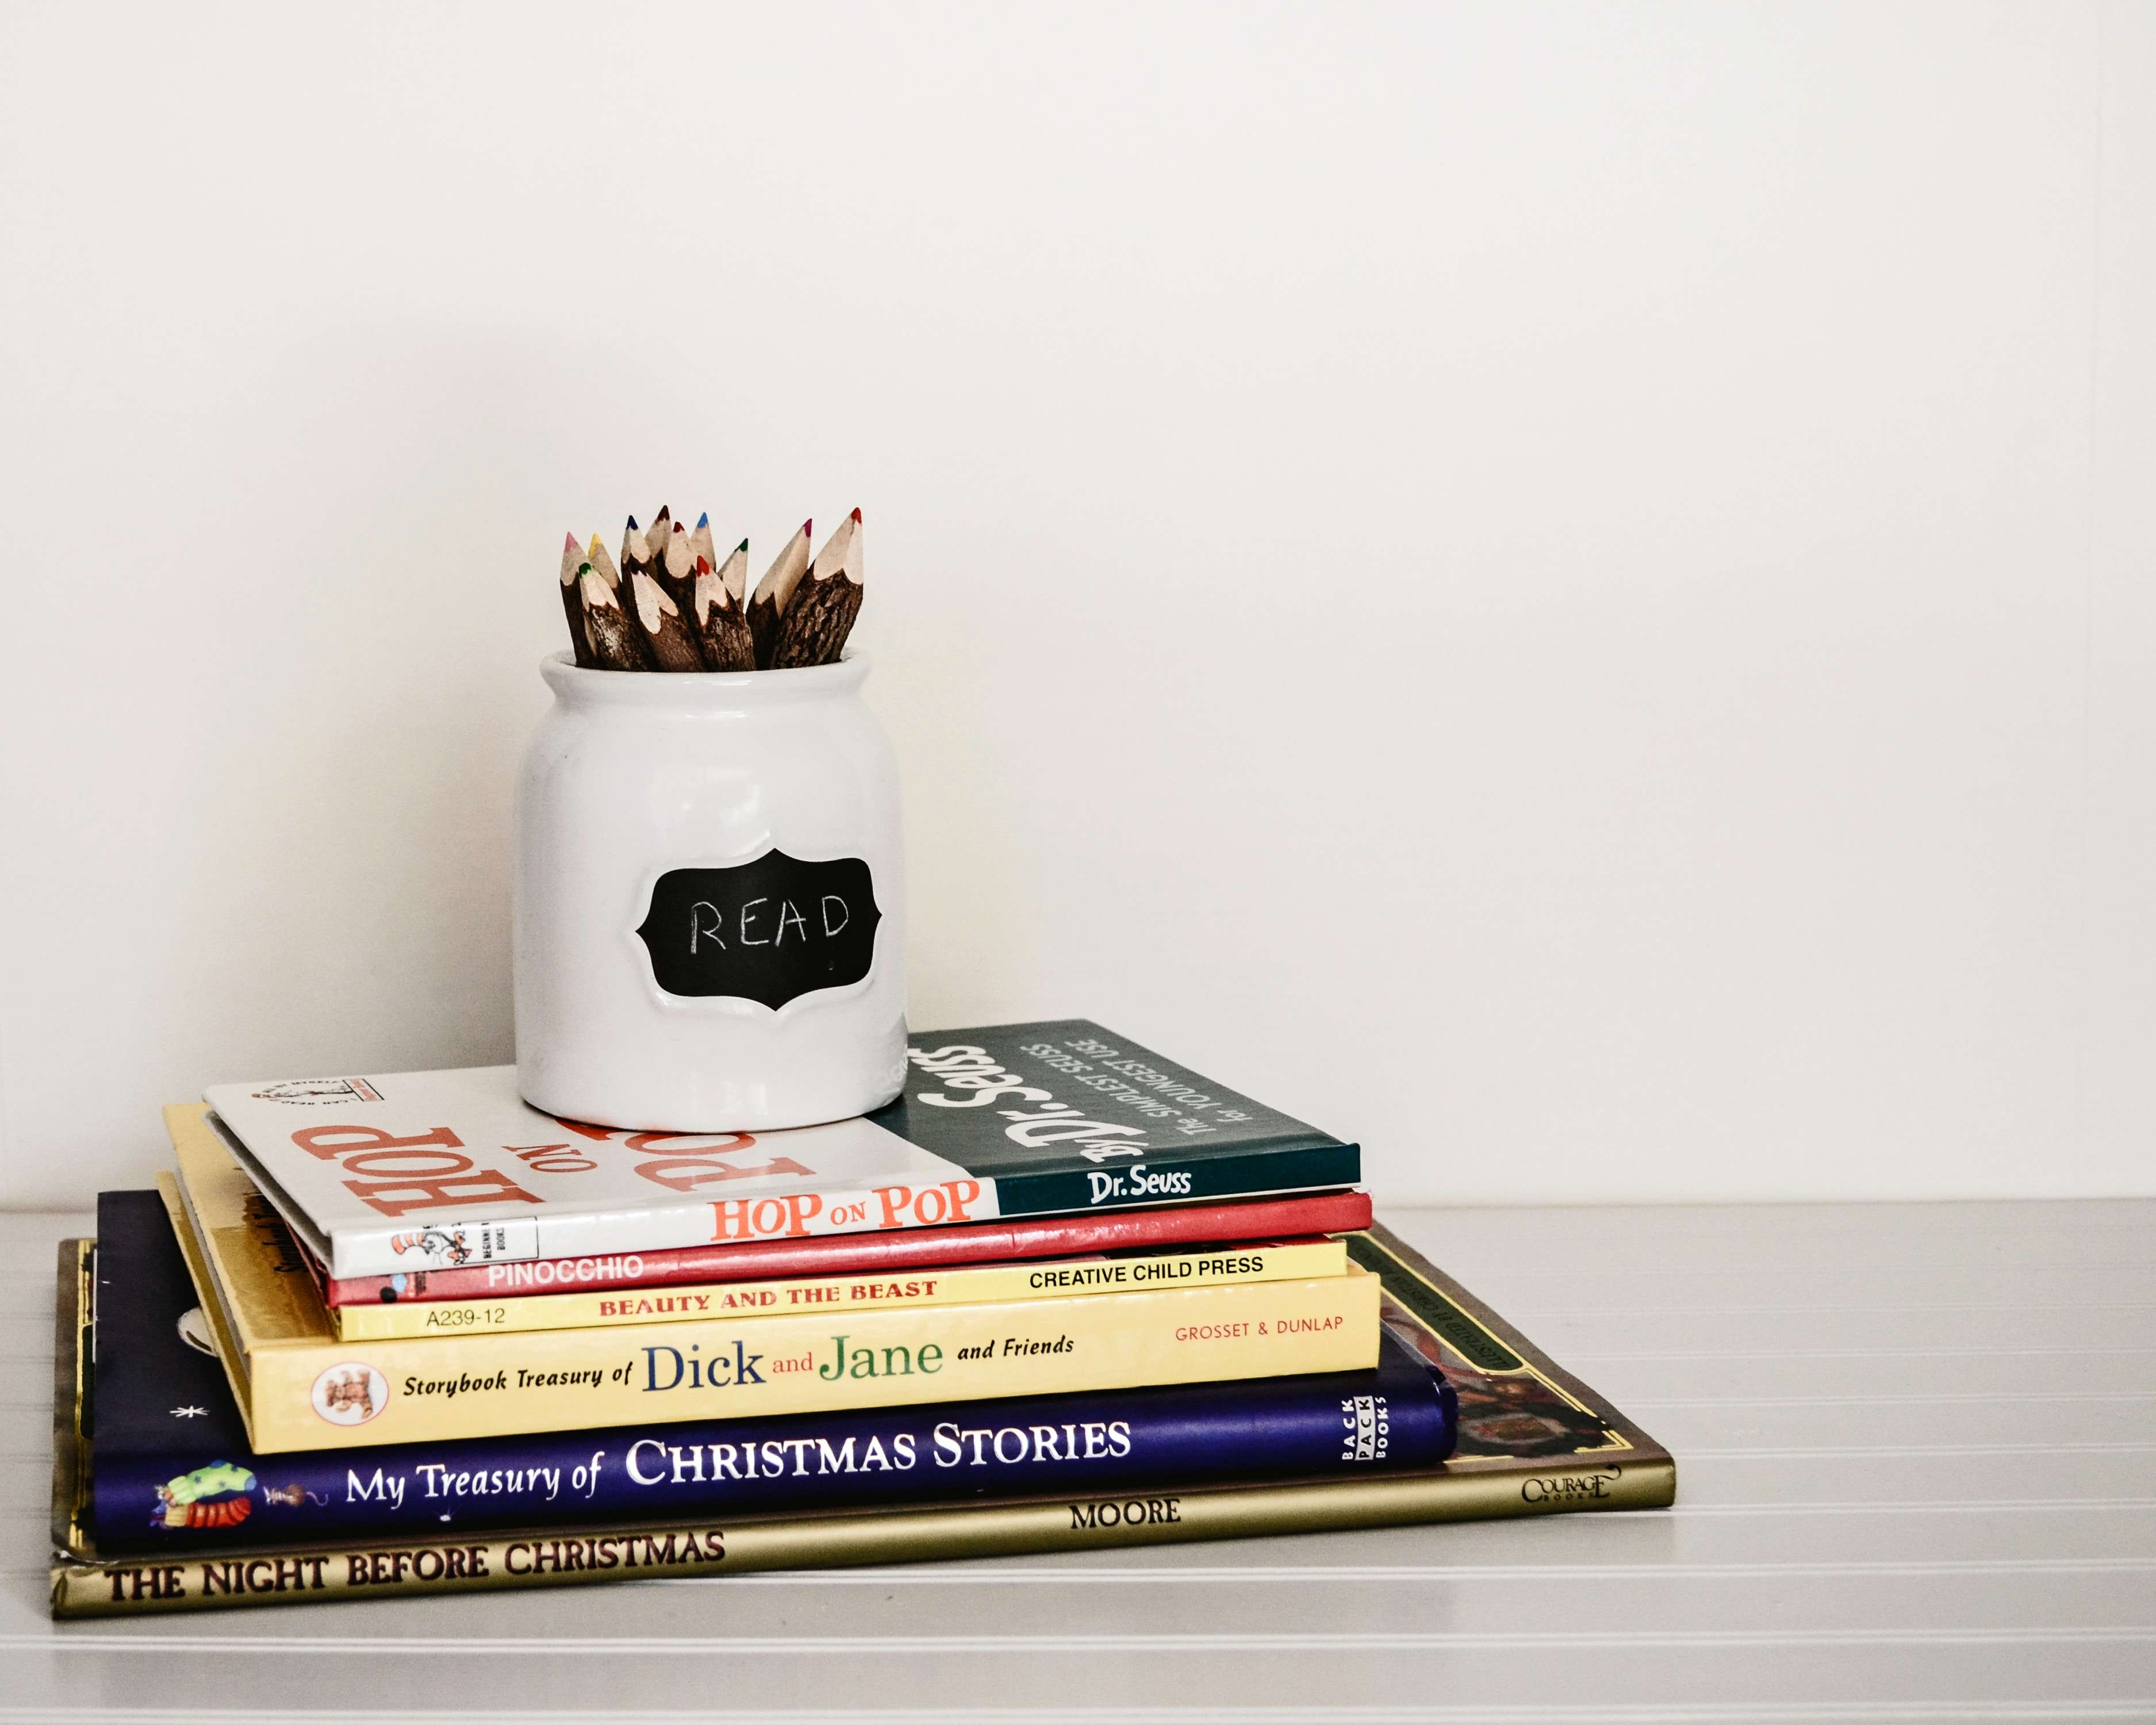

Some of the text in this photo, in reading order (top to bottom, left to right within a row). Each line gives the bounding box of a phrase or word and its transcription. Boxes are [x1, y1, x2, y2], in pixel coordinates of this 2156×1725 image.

[691, 895, 849, 954] READ
[910, 1045, 1052, 1107] Seuss
[1019, 1043, 1217, 1136] The SIMPLEST SEUSS
[1065, 1039, 1253, 1122] for YOUNGEST USE
[554, 1118, 817, 1192] PO
[996, 1103, 1146, 1148] Dr.
[290, 1125, 546, 1217] HOP
[501, 1143, 598, 1174] ON
[1087, 1164, 1192, 1204] Dr. Seuss
[709, 1193, 823, 1241] HOP
[872, 1179, 980, 1229] POP
[488, 1255, 645, 1288] PINOCCHIO
[599, 1280, 938, 1317] BEAUTY AND THE BEAST
[1029, 1256, 1265, 1289] CREATIVE CHILD PRESS
[426, 1307, 506, 1328] A239-12
[1175, 1315, 1344, 1341] GROSSET & DUNLAP
[403, 1334, 1075, 1398] Storybook Treasury of Dick and Jane and Friends
[1341, 1398, 1356, 1460] BACK
[1358, 1398, 1372, 1459] PACK
[1375, 1396, 1389, 1458] BOOKS
[346, 1419, 1133, 1510] My Treasury of CHRISTMAS STORIES
[1521, 1463, 1622, 1503] COURAGE
[1069, 1498, 1181, 1529] MOORE
[105, 1529, 727, 1604] THE NIGHT BEFORE CHRISTMAS
